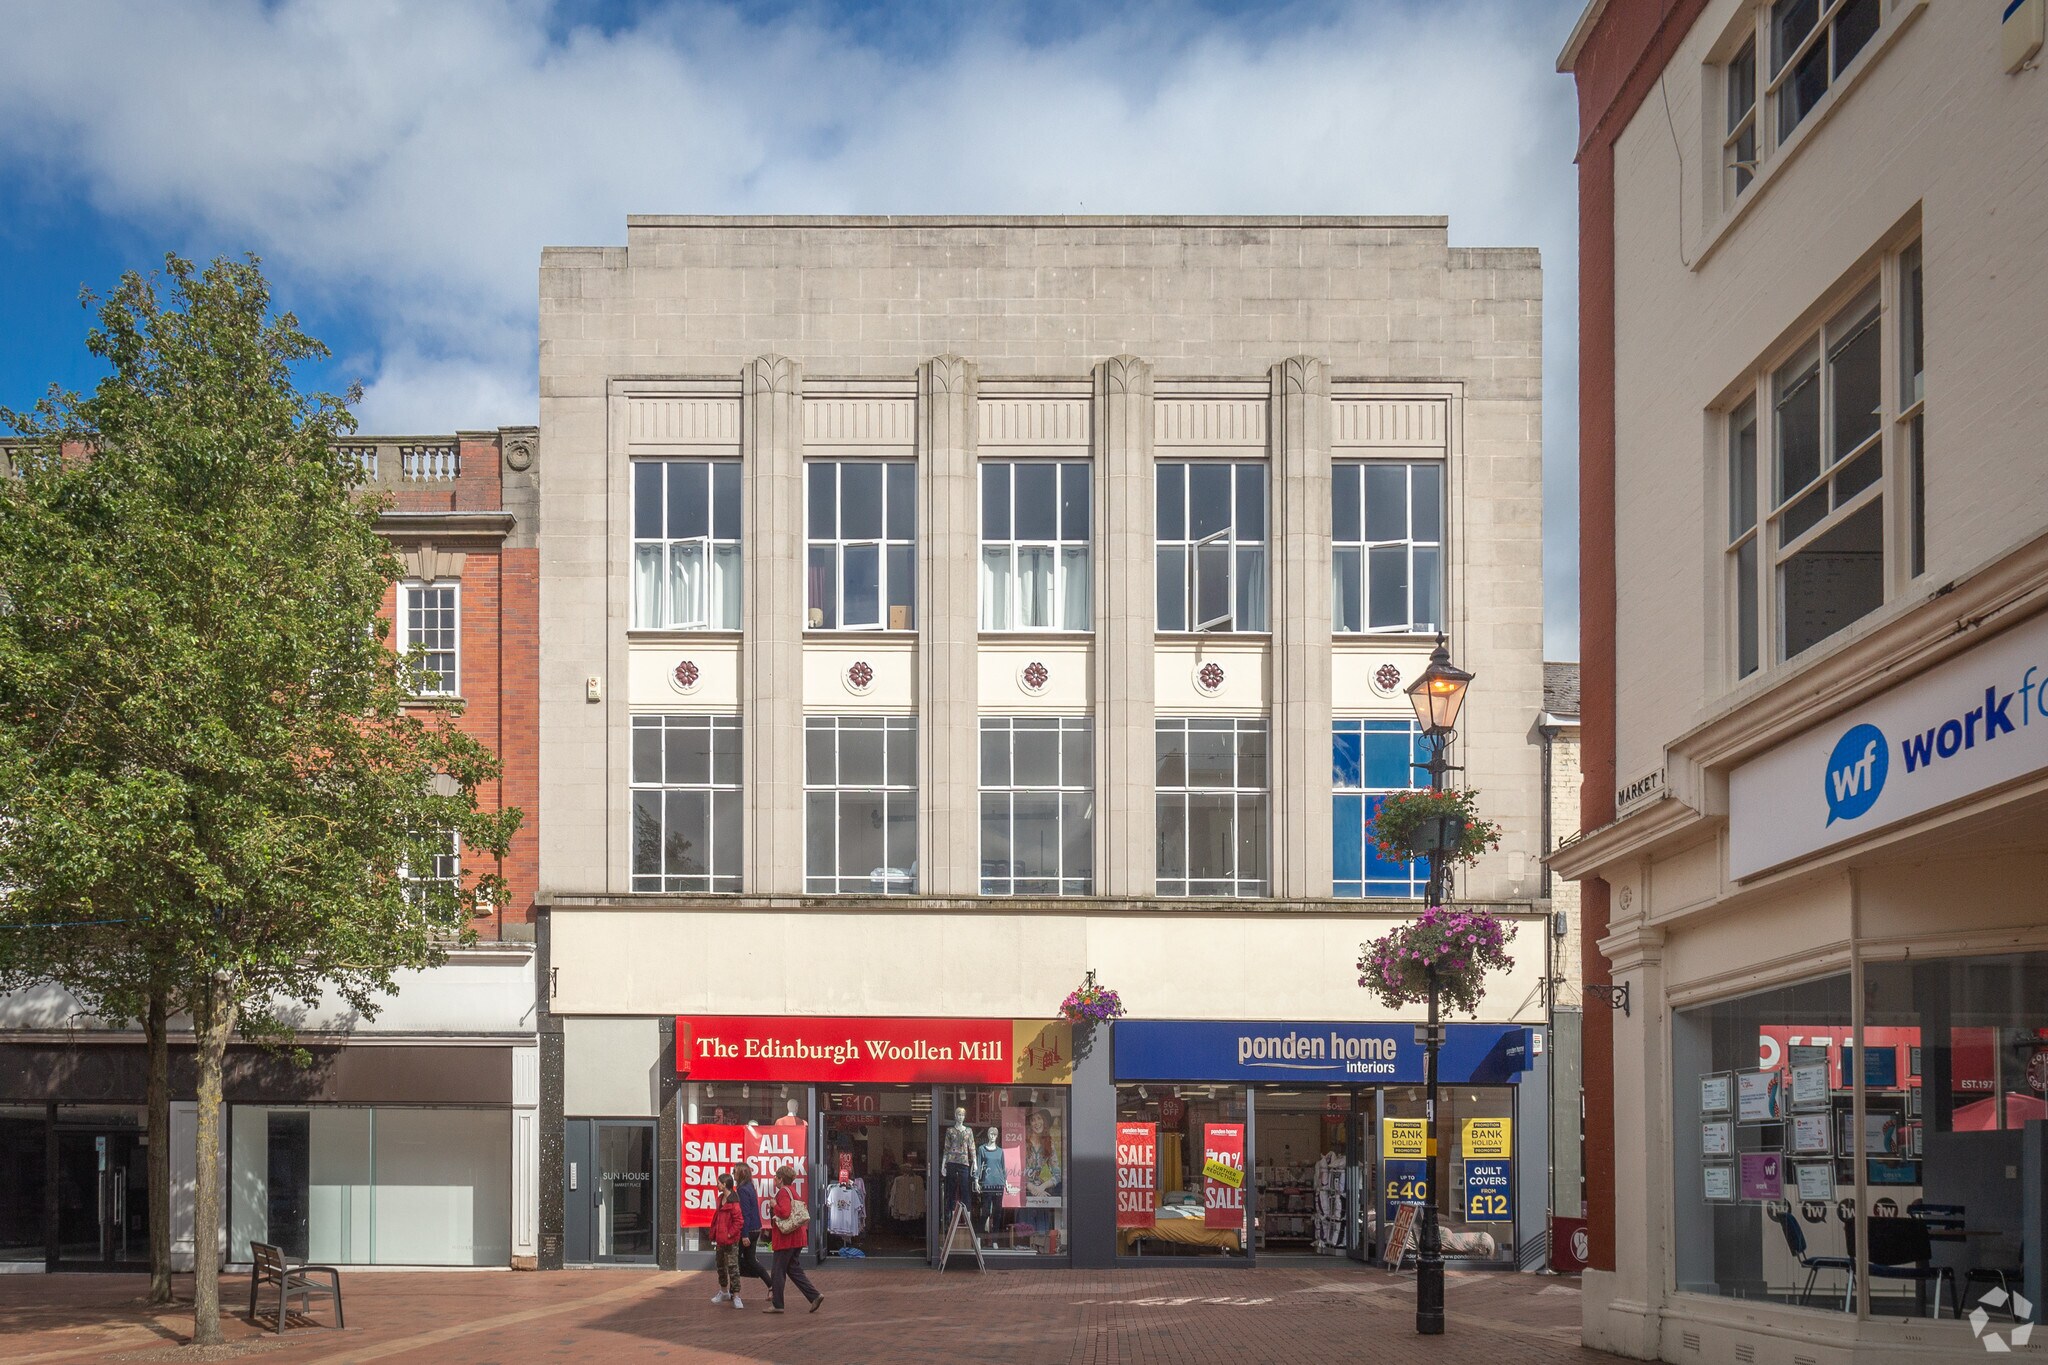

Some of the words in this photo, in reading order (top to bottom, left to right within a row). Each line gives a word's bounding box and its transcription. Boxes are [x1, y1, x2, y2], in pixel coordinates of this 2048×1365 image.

[1832, 740, 1877, 803] wf
[1618, 773, 1657, 806] MARKET
[696, 1037, 739, 1058] The
[743, 1037, 860, 1065] Edinburgh
[865, 1040, 953, 1061] Woollen
[958, 1040, 1003, 1061] Mill
[1238, 1031, 1325, 1065] ponden
[1330, 1032, 1397, 1060] home
[1346, 1061, 1396, 1074] interiors
[1162, 1108, 1180, 1116] OFF
[758, 1133, 794, 1154] ALL
[1005, 1133, 1023, 1142] £24
[1391, 1130, 1423, 1139] BANK
[1471, 1130, 1503, 1139] BANK
[685, 1141, 743, 1163] SALE
[1118, 1145, 1154, 1166] SALE
[602, 1172, 621, 1181] SUN
[622, 1172, 650, 1181] HOUSE
[1118, 1168, 1154, 1189] SALE
[1206, 1166, 1240, 1184] REDUCTIONS
[1212, 1163, 1237, 1178] FURTHER
[1474, 1167, 1502, 1175] QUILT
[1764, 1162, 1776, 1176] wf
[754, 1177, 805, 1198] MUT
[1386, 1181, 1427, 1200] £40
[1469, 1177, 1507, 1185] COVERS
[1118, 1191, 1154, 1213] SALE
[1205, 1187, 1243, 1209] SALE
[1470, 1195, 1508, 1214] £12
[760, 1199, 772, 1221] G
